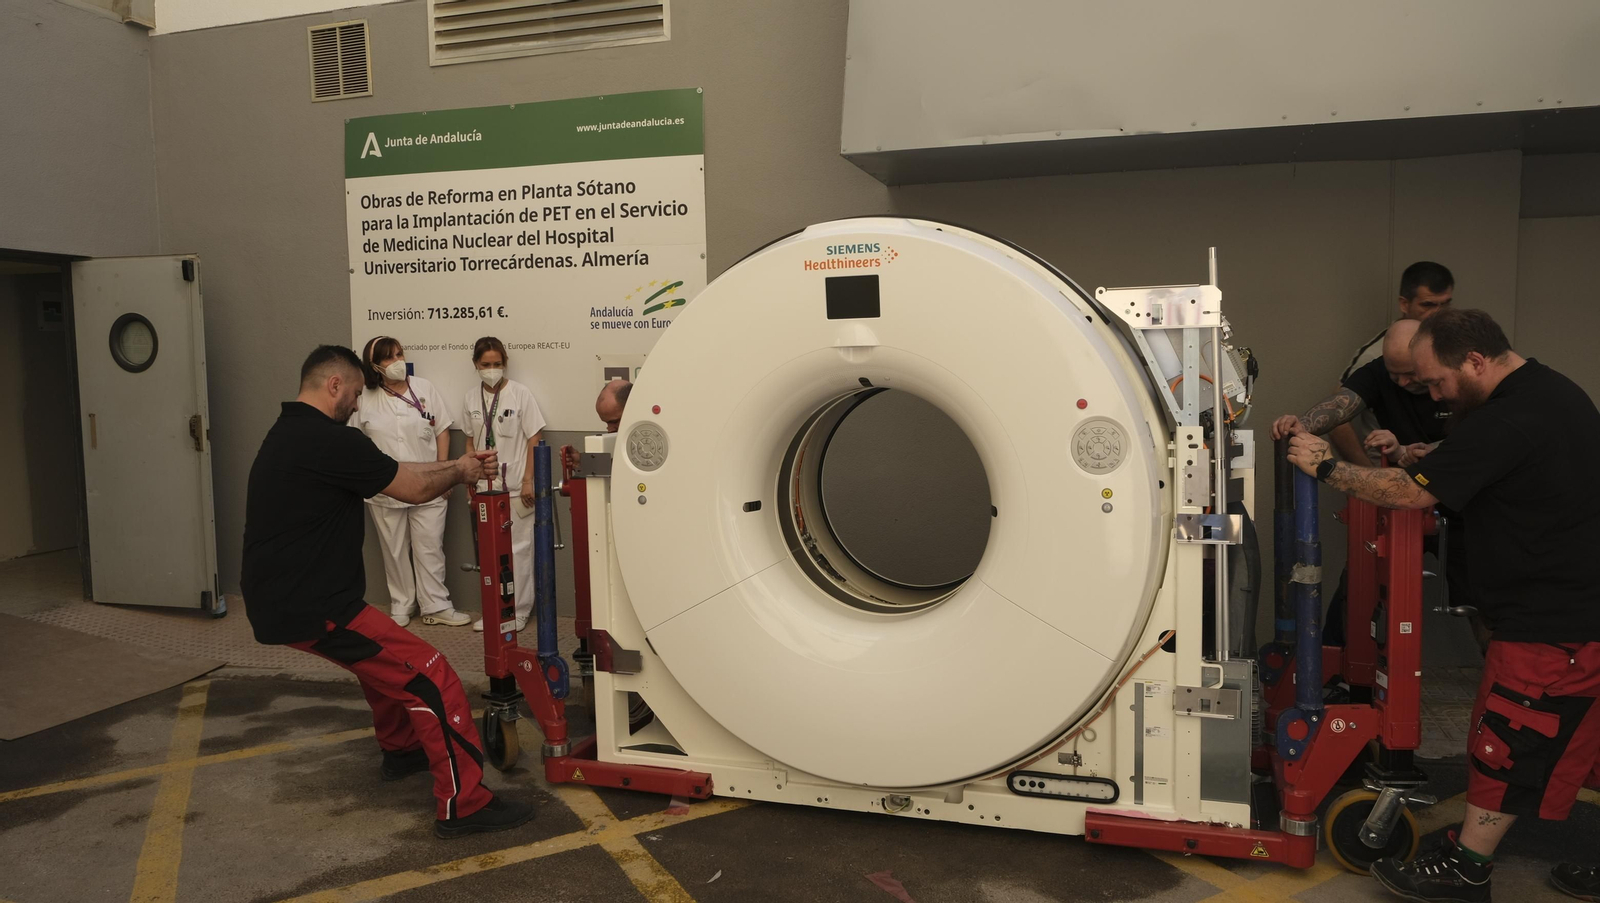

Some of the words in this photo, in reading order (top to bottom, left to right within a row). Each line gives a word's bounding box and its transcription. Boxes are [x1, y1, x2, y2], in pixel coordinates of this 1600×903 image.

[576, 117, 685, 132] www.juntadeandalucia.es
[384, 136, 413, 148] Junta
[415, 134, 428, 145] de
[429, 128, 482, 144] Andalucía
[360, 194, 402, 209] Obras
[405, 191, 424, 206] de
[428, 189, 494, 205] Reforma
[498, 188, 517, 201] en
[522, 183, 572, 200] Planta
[577, 180, 636, 197] Sótano
[361, 217, 393, 236] para
[396, 214, 409, 230] la
[412, 208, 514, 232] Implantación
[519, 207, 539, 223] de
[543, 205, 571, 222] PET
[575, 207, 596, 220] en
[600, 202, 615, 219] el
[620, 200, 688, 218] Servicio
[362, 238, 380, 253] de
[383, 235, 448, 253] Medicina
[452, 232, 513, 249] Nuclear
[516, 230, 541, 246] del
[545, 227, 614, 248] Hospital
[826, 242, 881, 255] SIEMENS
[364, 257, 456, 275] Universitario
[460, 253, 578, 271] Torrecárdenas.
[581, 249, 649, 267] Almería
[804, 257, 881, 271] Healthineers
[367, 307, 425, 321] Inversión:
[427, 306, 493, 320] 713.285,61
[497, 306, 509, 318] €.
[590, 305, 634, 317] Andalucía
[590, 321, 600, 330] se
[602, 320, 632, 329] mueve
[633, 320, 650, 329] con
[651, 317, 673, 329] Euro
[429, 344, 440, 352] por
[441, 343, 447, 351] el
[448, 343, 468, 351] Fondo
[508, 342, 536, 351] Europea
[537, 341, 571, 350] REACT-EU
